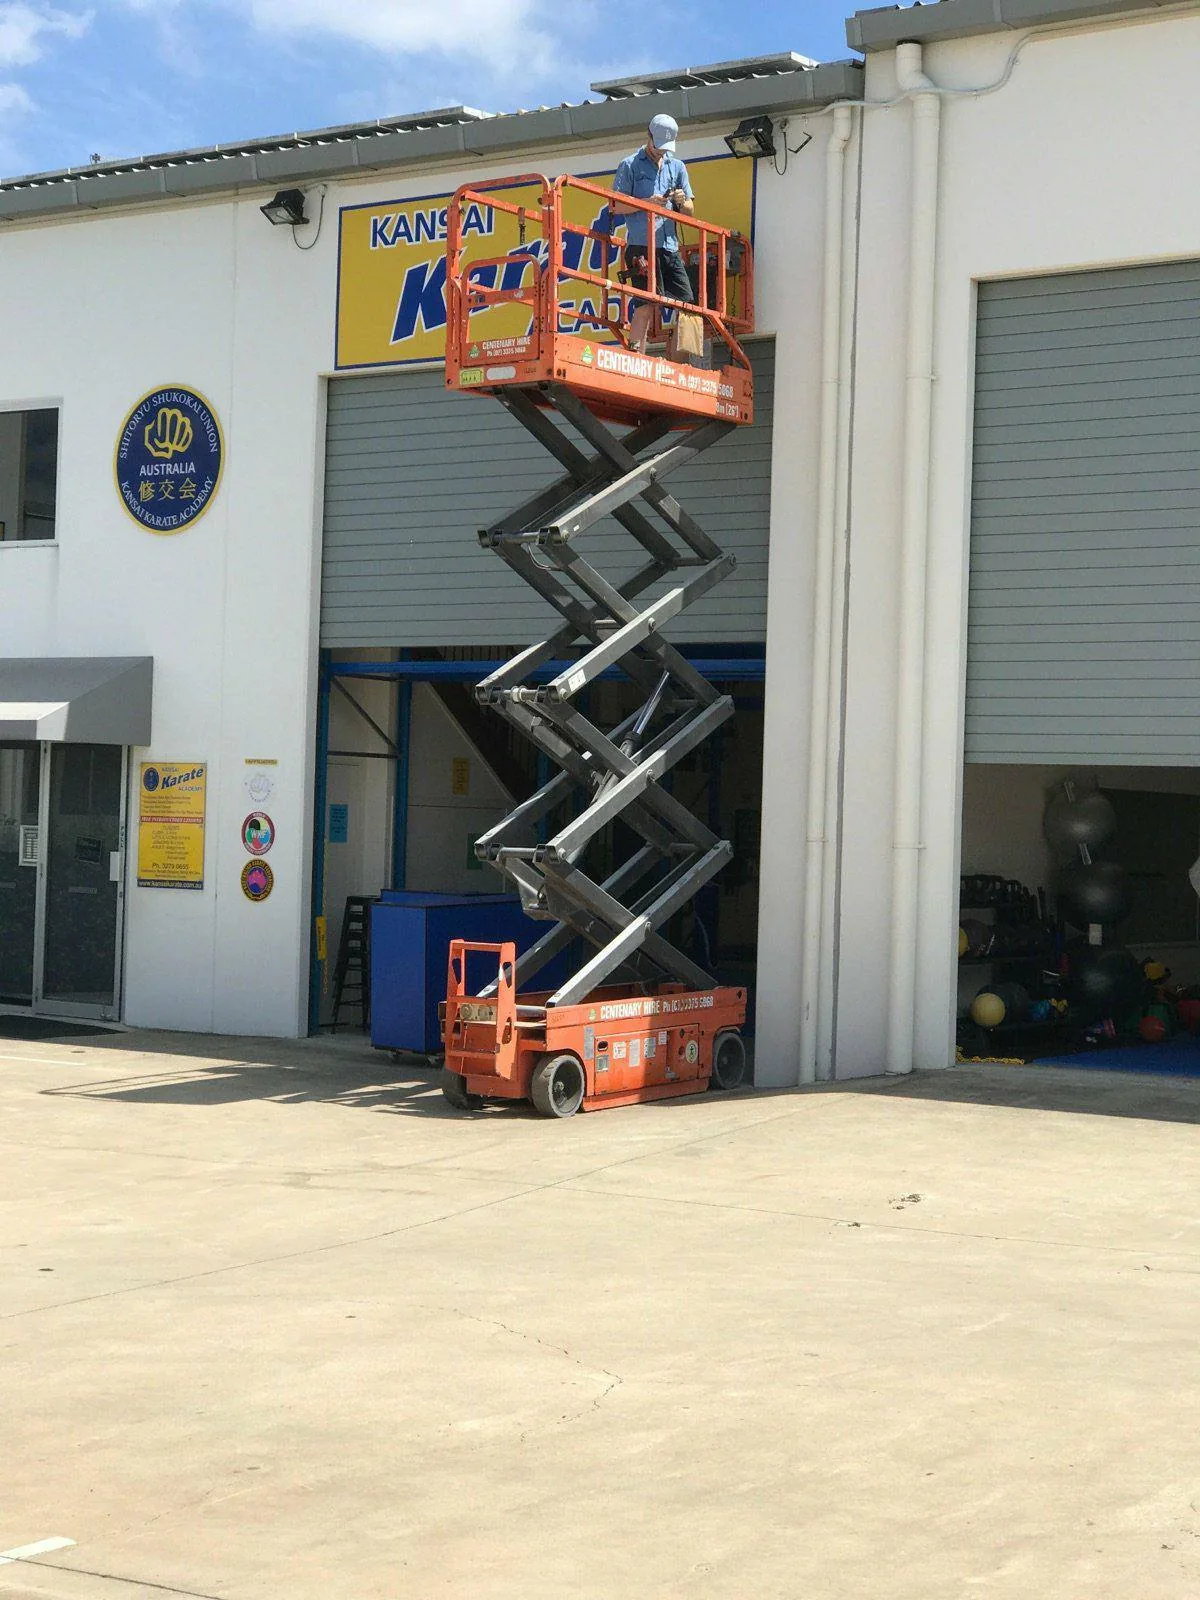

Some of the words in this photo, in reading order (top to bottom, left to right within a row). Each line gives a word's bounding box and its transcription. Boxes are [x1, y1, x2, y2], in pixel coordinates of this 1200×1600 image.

[482, 338, 516, 350] CENTENARY
[516, 336, 531, 345] HIRE
[598, 348, 653, 379] CENTENARY
[120, 401, 150, 459] SHITORYU
[153, 392, 202, 414] SHUKOKAI
[200, 409, 218, 453] UNION
[139, 462, 196, 476] AUSTRALIA
[121, 480, 145, 518] KANSAI
[144, 512, 178, 526] KARATE
[179, 476, 214, 522] ACADEMY
[138, 477, 197, 502] 修交会
[161, 768, 203, 790] Karate
[600, 1001, 642, 1020] CENTENARY
[644, 1000, 660, 1014] HIRE
